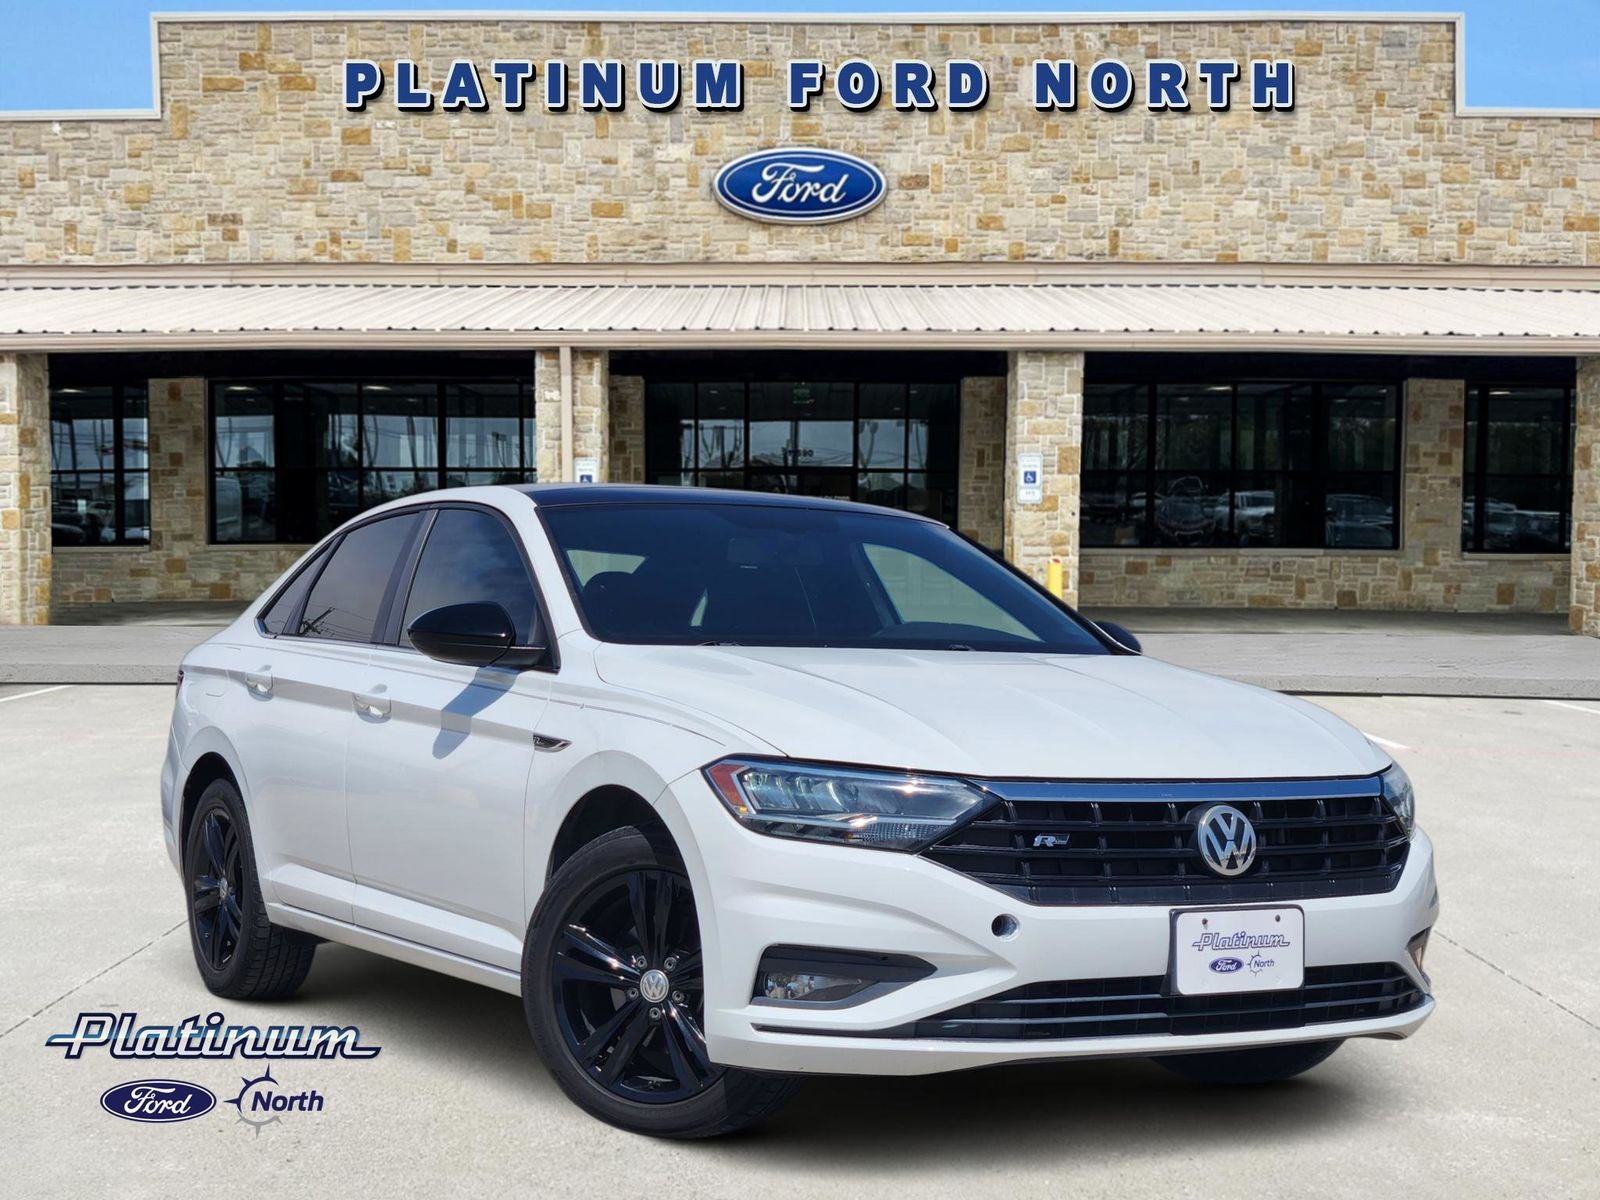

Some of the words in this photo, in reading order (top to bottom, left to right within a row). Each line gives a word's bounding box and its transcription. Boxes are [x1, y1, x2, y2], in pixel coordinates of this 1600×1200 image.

[343, 59, 744, 112] PLATINUM
[787, 59, 989, 112] FORD
[1034, 59, 1296, 112] NORTH
[750, 162, 849, 205] Ford
[1192, 930, 1291, 951] Platinum
[1215, 959, 1237, 971] Ford
[1253, 958, 1275, 968] North
